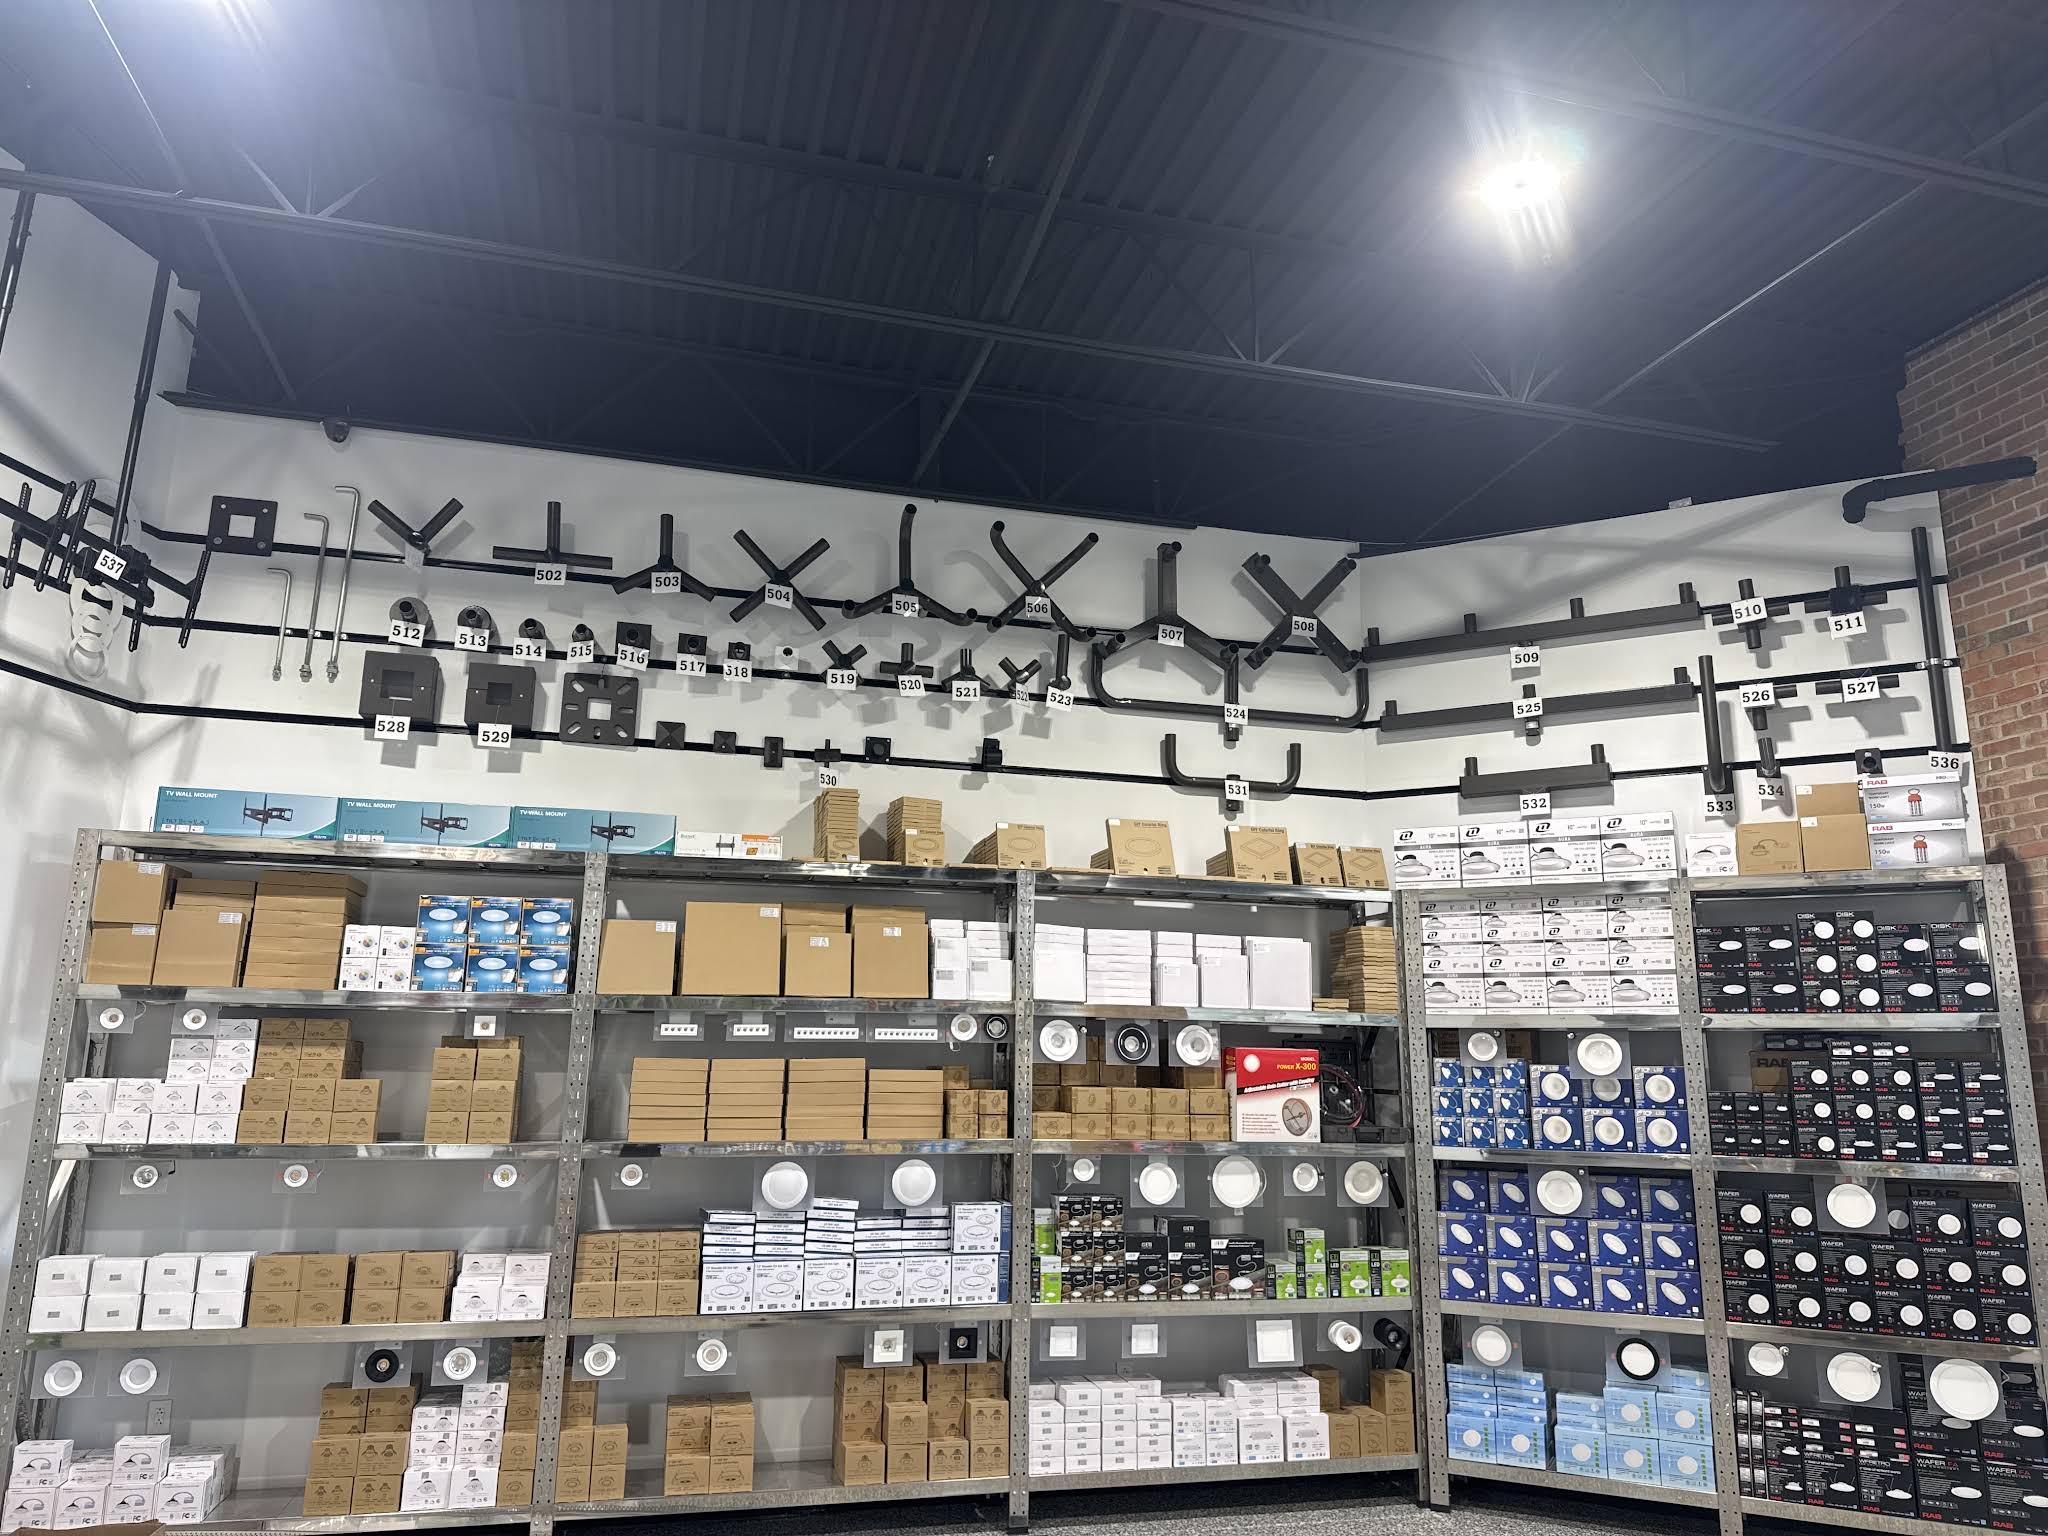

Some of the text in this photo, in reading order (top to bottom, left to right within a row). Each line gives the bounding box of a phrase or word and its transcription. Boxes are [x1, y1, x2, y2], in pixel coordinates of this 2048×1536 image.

[100, 554, 124, 574] 537
[536, 570, 562, 581] 502
[655, 576, 680, 587] 503
[766, 588, 791, 602] 504
[895, 600, 917, 613] 505
[1027, 602, 1048, 614] 506
[1734, 604, 1762, 618] 510
[1294, 620, 1315, 633] 508
[1834, 616, 1863, 630] 511
[392, 626, 421, 640] 512
[1160, 628, 1183, 641] 507
[458, 634, 487, 646] 513
[514, 644, 542, 657] 514
[570, 646, 592, 658] 515
[620, 650, 645, 664] 516
[1514, 652, 1539, 664] 509
[680, 662, 705, 673] 517
[725, 667, 748, 678] 518
[830, 674, 854, 684] 519
[901, 680, 922, 690] 520
[955, 687, 978, 698] 521
[1847, 680, 1876, 694] 527
[1016, 689, 1029, 702] 522
[1050, 693, 1072, 706] 523
[1742, 689, 1770, 703] 526
[1226, 708, 1246, 720] 524
[1516, 702, 1541, 714] 525
[377, 720, 405, 733] 528
[482, 730, 510, 743] 529
[1930, 756, 1960, 770] 536
[819, 774, 838, 787] 530
[1228, 784, 1248, 796] 531
[1758, 784, 1784, 796] 534
[1522, 797, 1547, 809] 532
[1706, 800, 1733, 812] 533
[1987, 1466, 2017, 1474] WAFER
